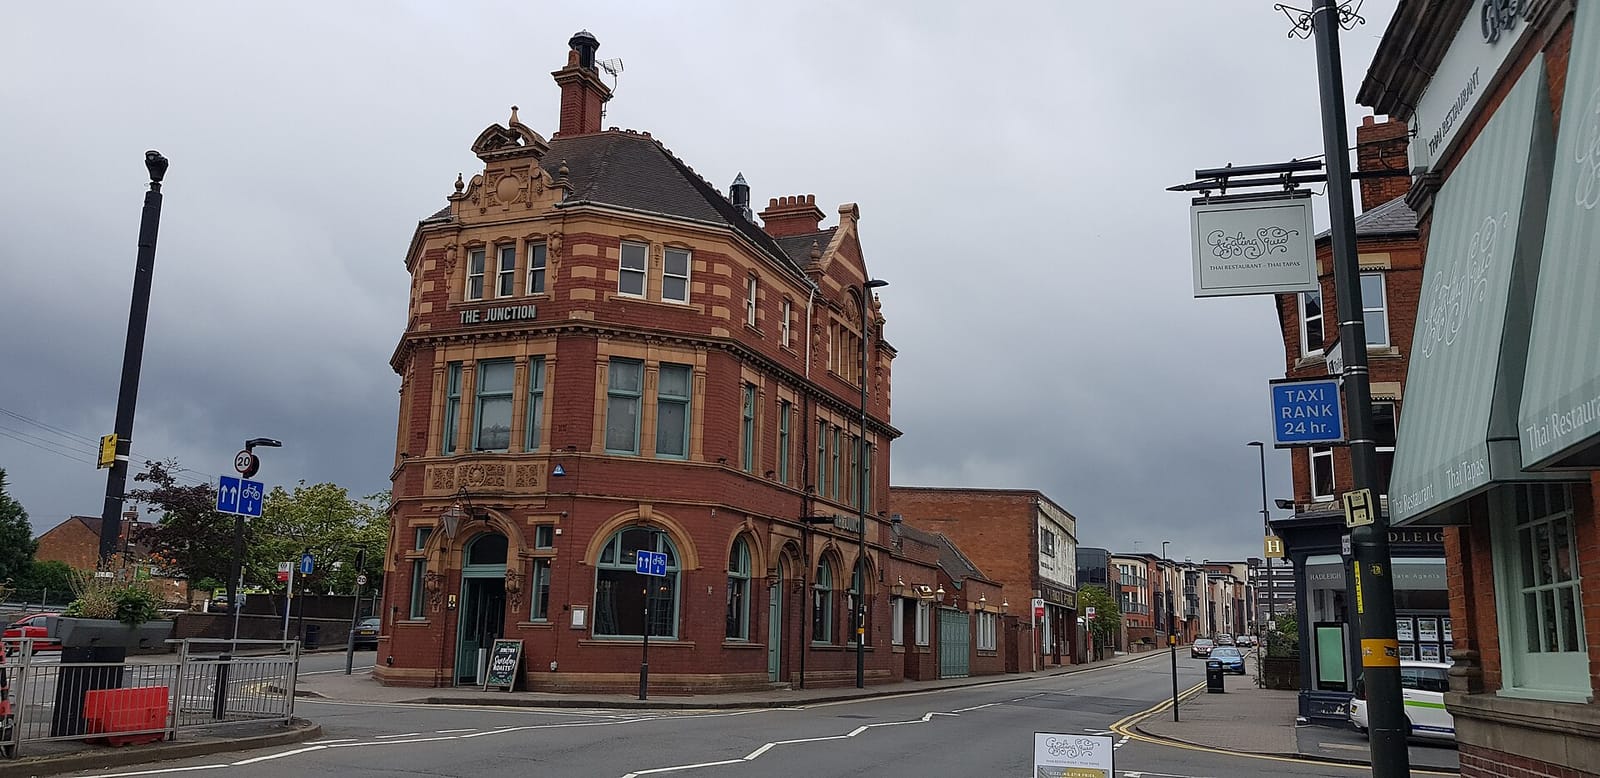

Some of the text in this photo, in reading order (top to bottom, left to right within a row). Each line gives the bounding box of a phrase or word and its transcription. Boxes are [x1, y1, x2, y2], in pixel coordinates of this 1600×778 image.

[1428, 66, 1480, 156] THAI RESTAURANT
[1207, 226, 1299, 260] Giggling Squid
[460, 304, 536, 324] THE JUNCTION
[1284, 389, 1324, 403] TAXI
[1282, 404, 1333, 419] RANK
[1284, 421, 1332, 435] 24 hr.
[1526, 417, 1550, 452] Thai
[237, 456, 251, 467] 20
[1445, 458, 1485, 490] Thai Tapas
[1347, 492, 1371, 523] H
[1403, 483, 1434, 513] Restaurant
[1267, 540, 1281, 553] H
[1310, 572, 1342, 581] HADLEIGH
